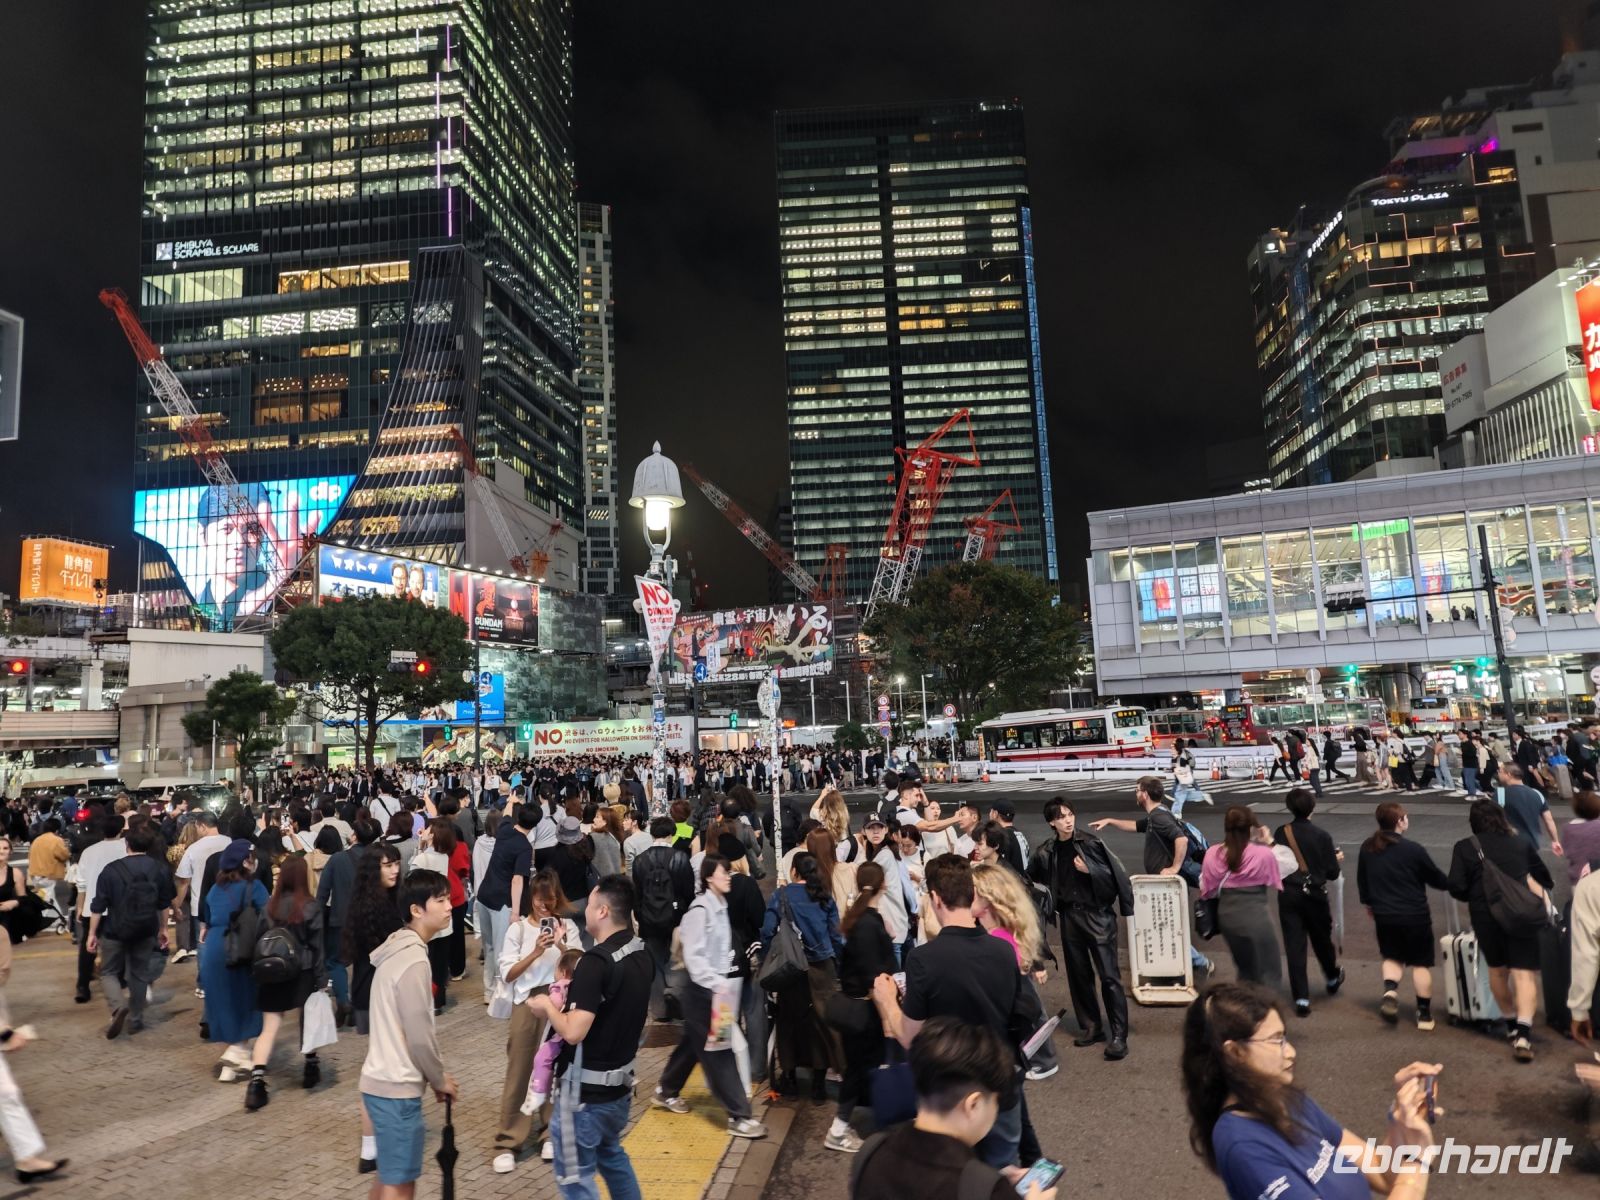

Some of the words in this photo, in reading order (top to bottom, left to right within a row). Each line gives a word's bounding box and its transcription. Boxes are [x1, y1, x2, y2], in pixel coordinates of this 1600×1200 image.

[1371, 197, 1409, 206] TOKYU
[1410, 192, 1449, 202] PLAZA
[174, 239, 213, 251] SHIBUYA
[174, 247, 221, 260] SCRAMBLE
[222, 243, 259, 255] SQUARE
[641, 583, 670, 606] NO
[475, 616, 503, 629] GUNDAM
[534, 729, 563, 746] NO
